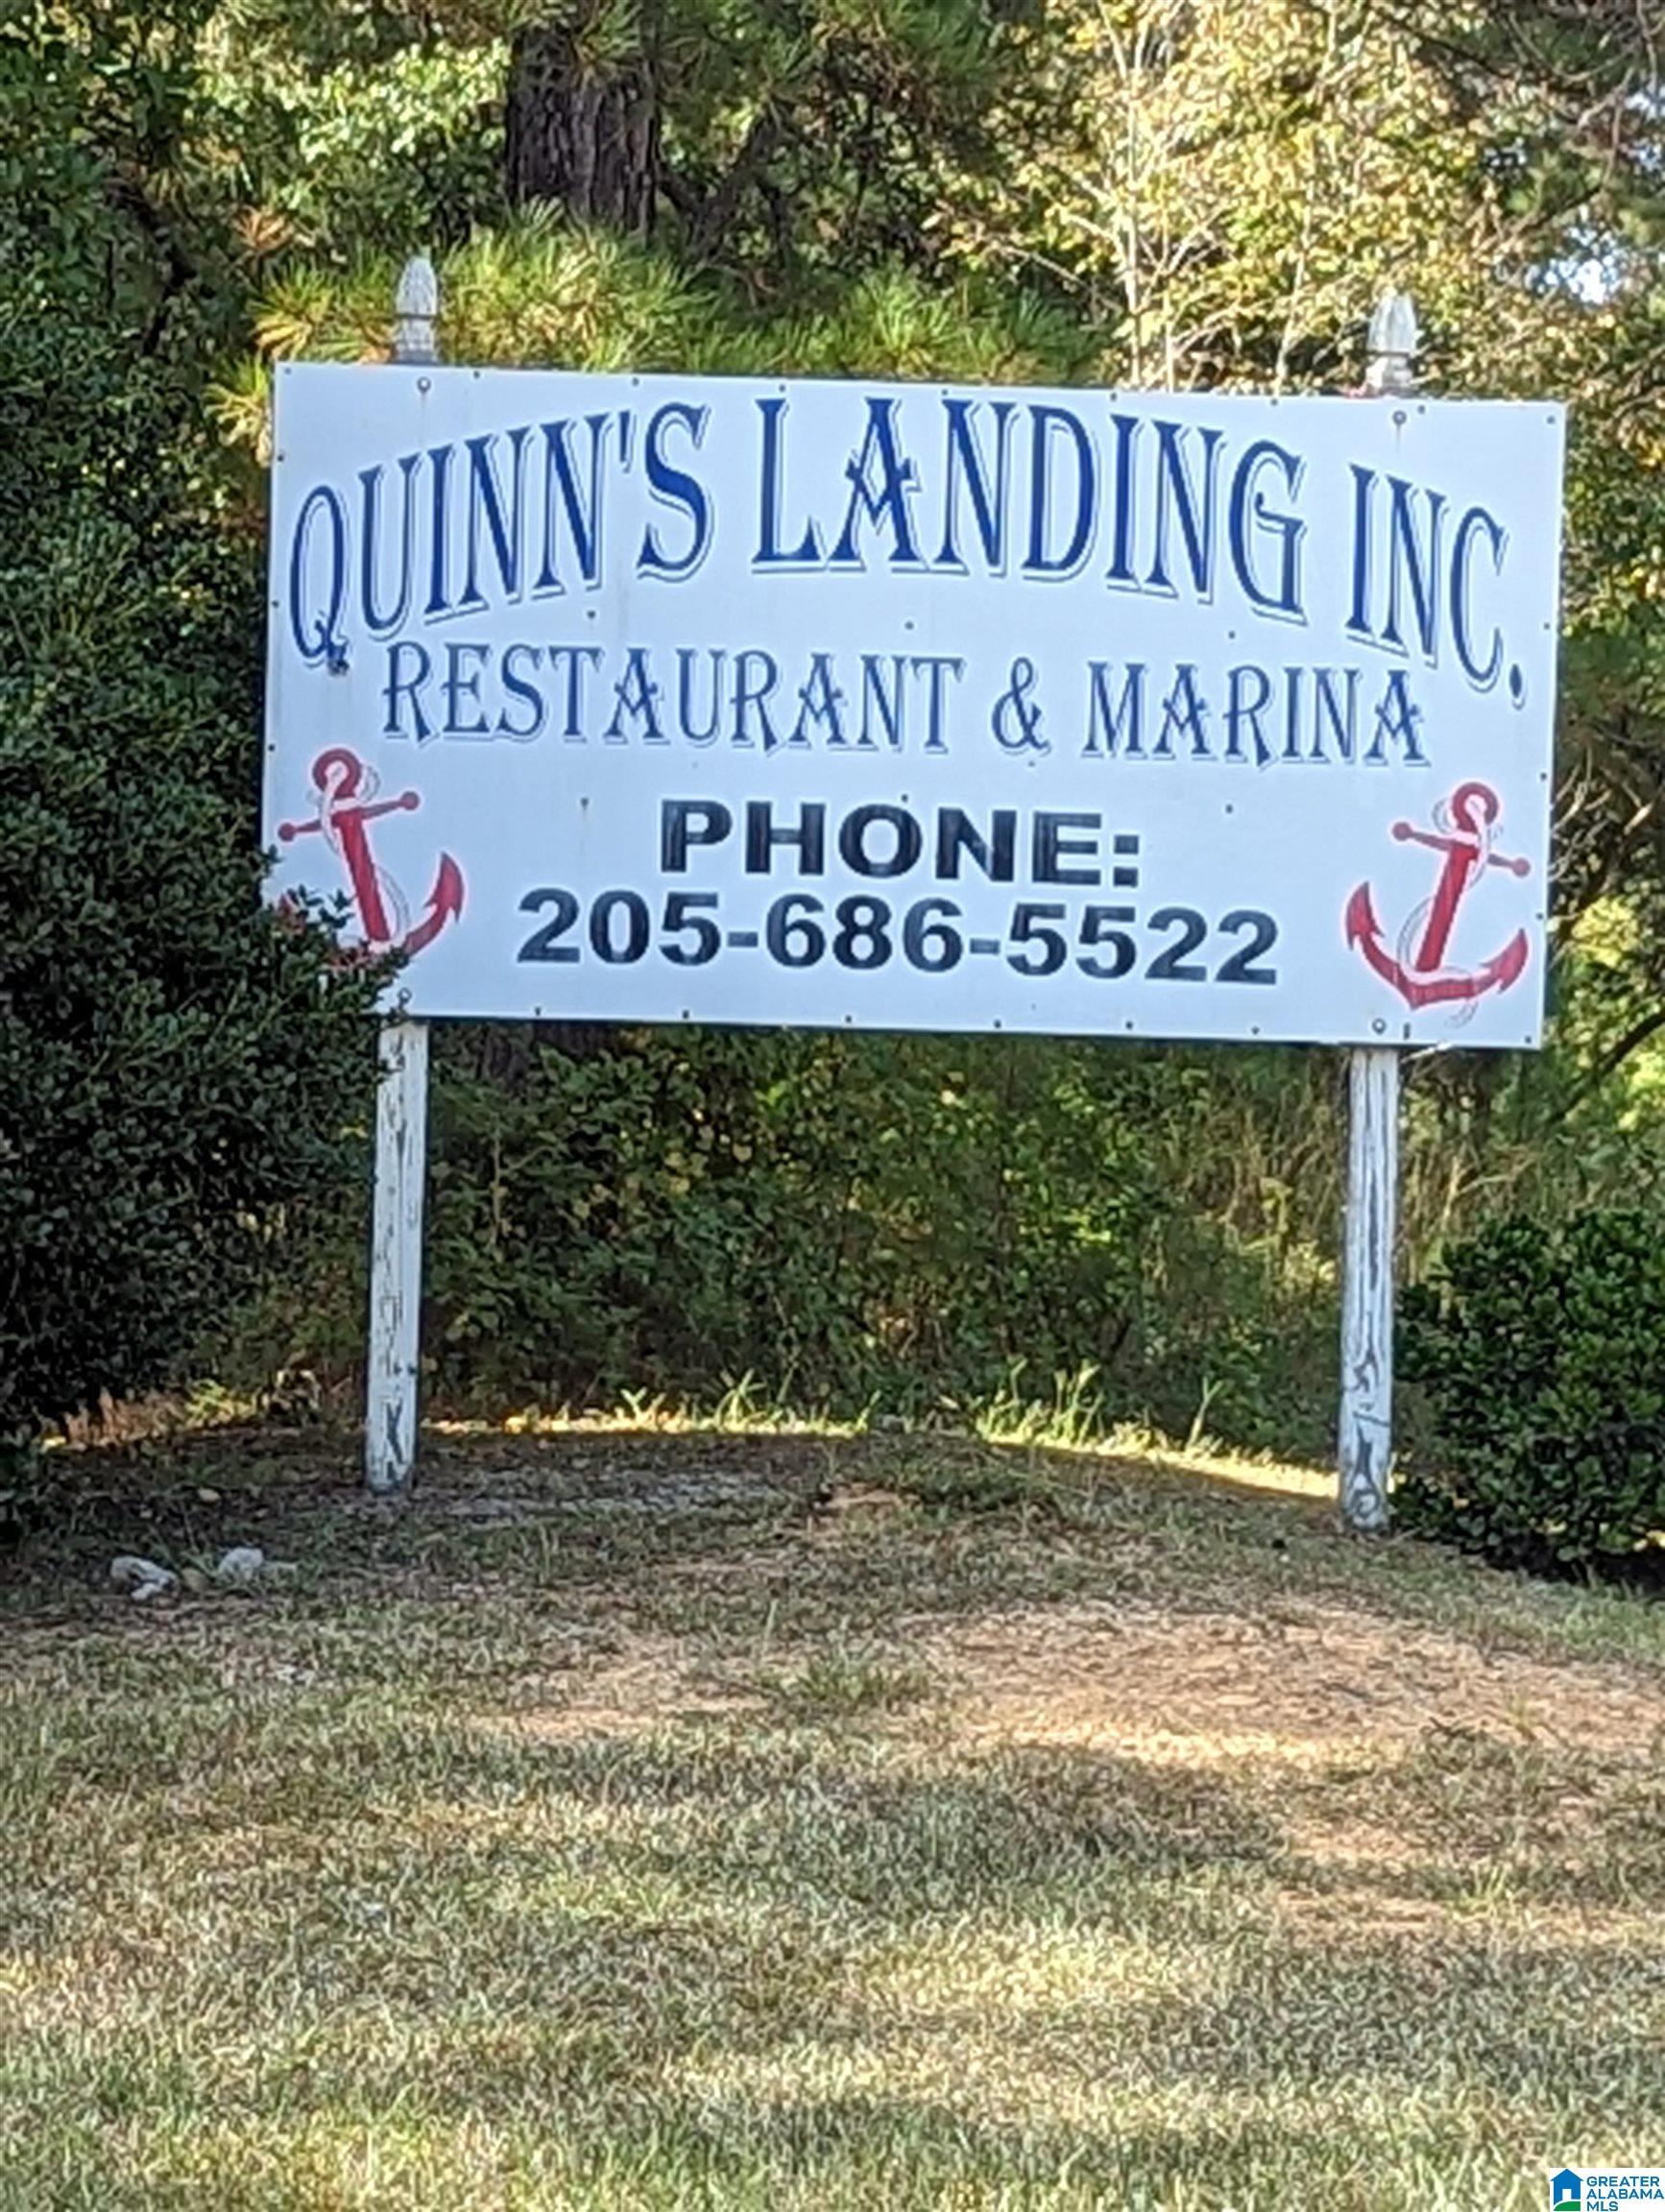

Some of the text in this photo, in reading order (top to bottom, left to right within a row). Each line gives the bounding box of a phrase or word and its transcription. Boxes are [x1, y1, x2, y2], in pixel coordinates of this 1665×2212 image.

[290, 398, 1526, 709] QUINN'S LANDING INC.
[382, 640, 1431, 769] RESTAURANT & MARINA
[660, 799, 1140, 888] PHONE:
[517, 888, 1278, 985] 205-686-5522
